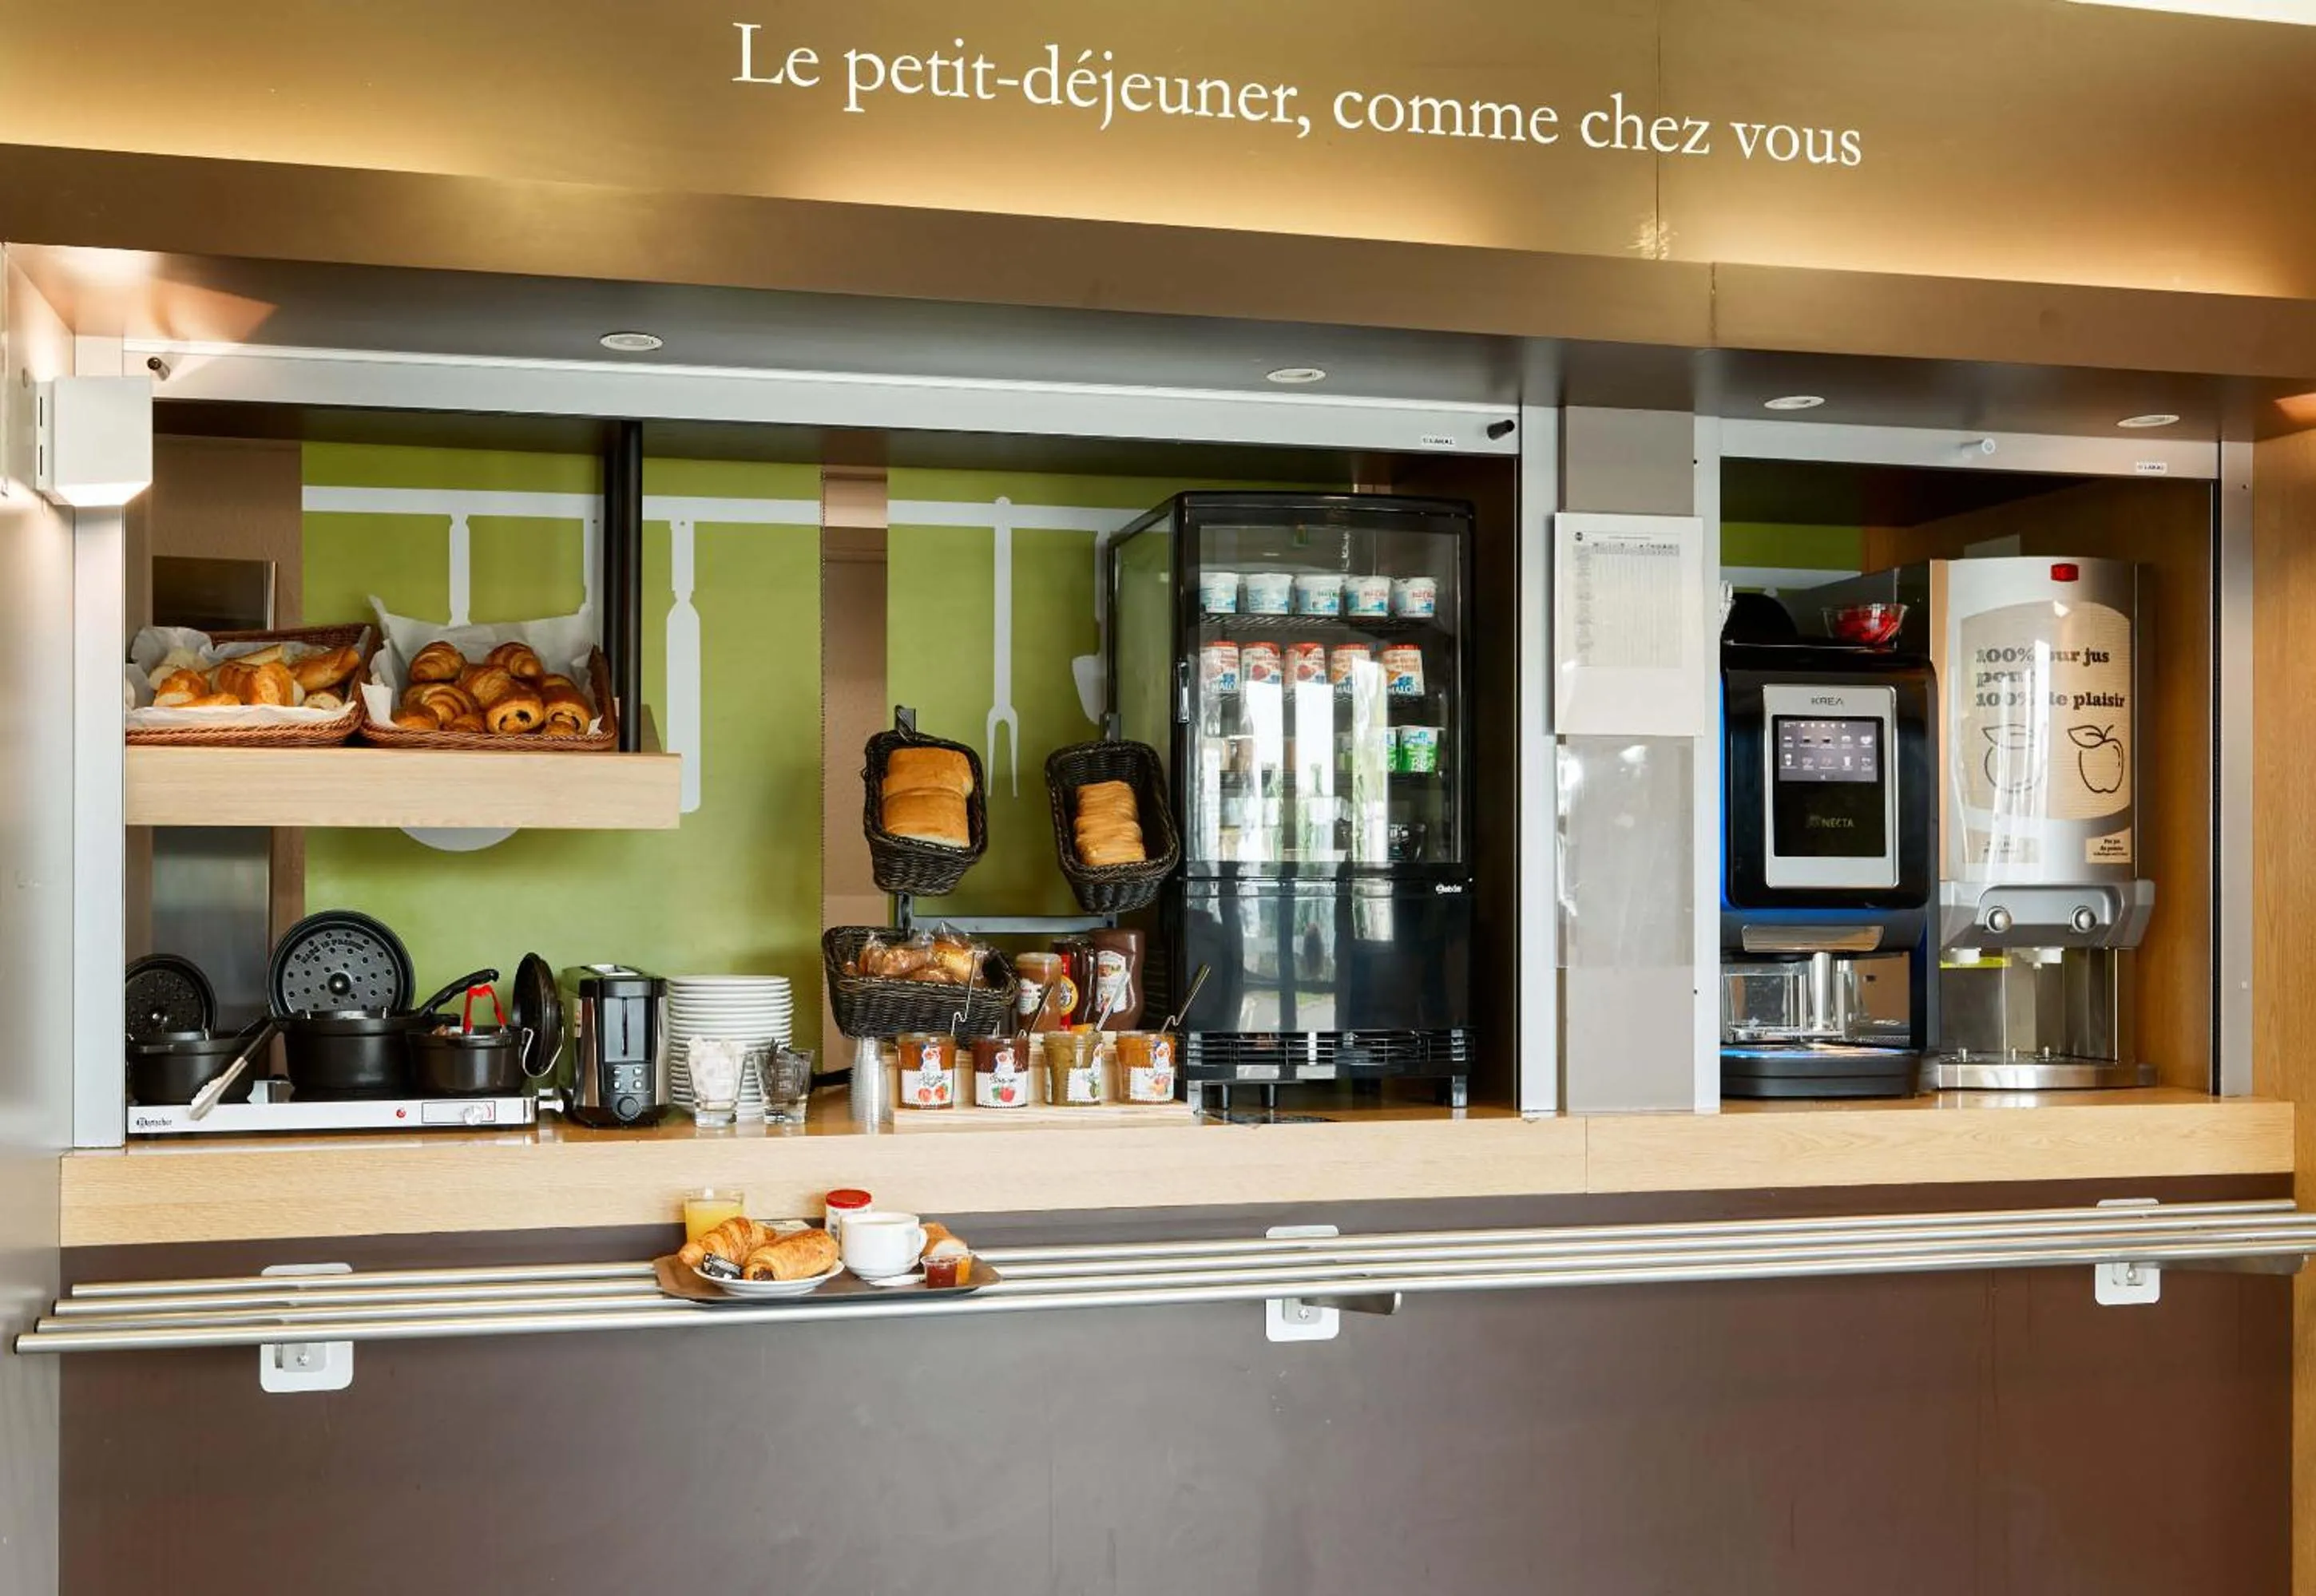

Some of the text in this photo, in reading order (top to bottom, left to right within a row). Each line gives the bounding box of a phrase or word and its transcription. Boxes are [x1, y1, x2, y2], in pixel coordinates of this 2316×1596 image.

[733, 23, 1861, 165] Le petit-déjeuner, comme chez vous
[1976, 648, 2035, 663] 100%
[2083, 648, 2110, 667] jus
[1811, 697, 1843, 706] KREA
[2073, 691, 2125, 710] plaisir
[1822, 818, 1854, 828] NECTA
